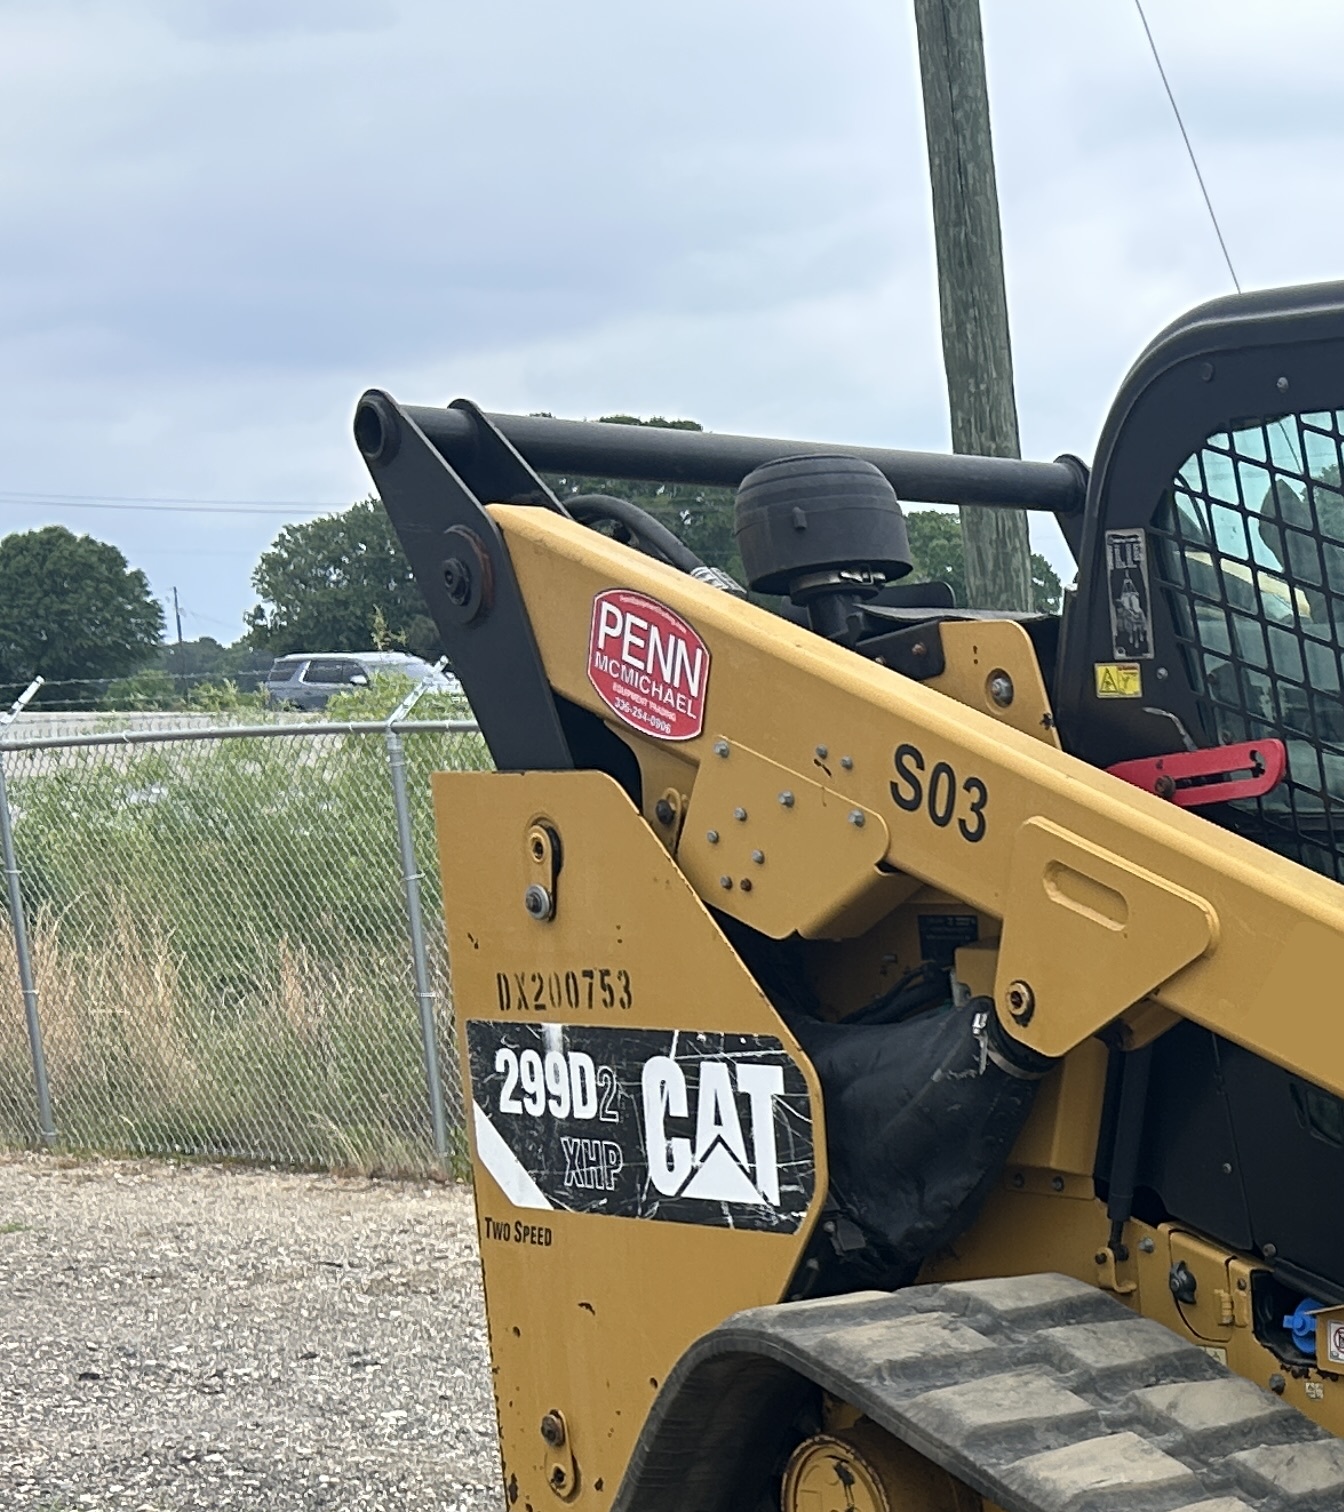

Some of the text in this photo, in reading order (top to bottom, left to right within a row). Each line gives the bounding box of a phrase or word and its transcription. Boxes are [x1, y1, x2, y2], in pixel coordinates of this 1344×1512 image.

[594, 651, 697, 720] MCMICHAEL
[598, 601, 703, 698] PENN
[889, 743, 988, 843] S03
[496, 968, 632, 1012] DX200753
[561, 1136, 623, 1191] XHP
[642, 1055, 785, 1207] CAT
